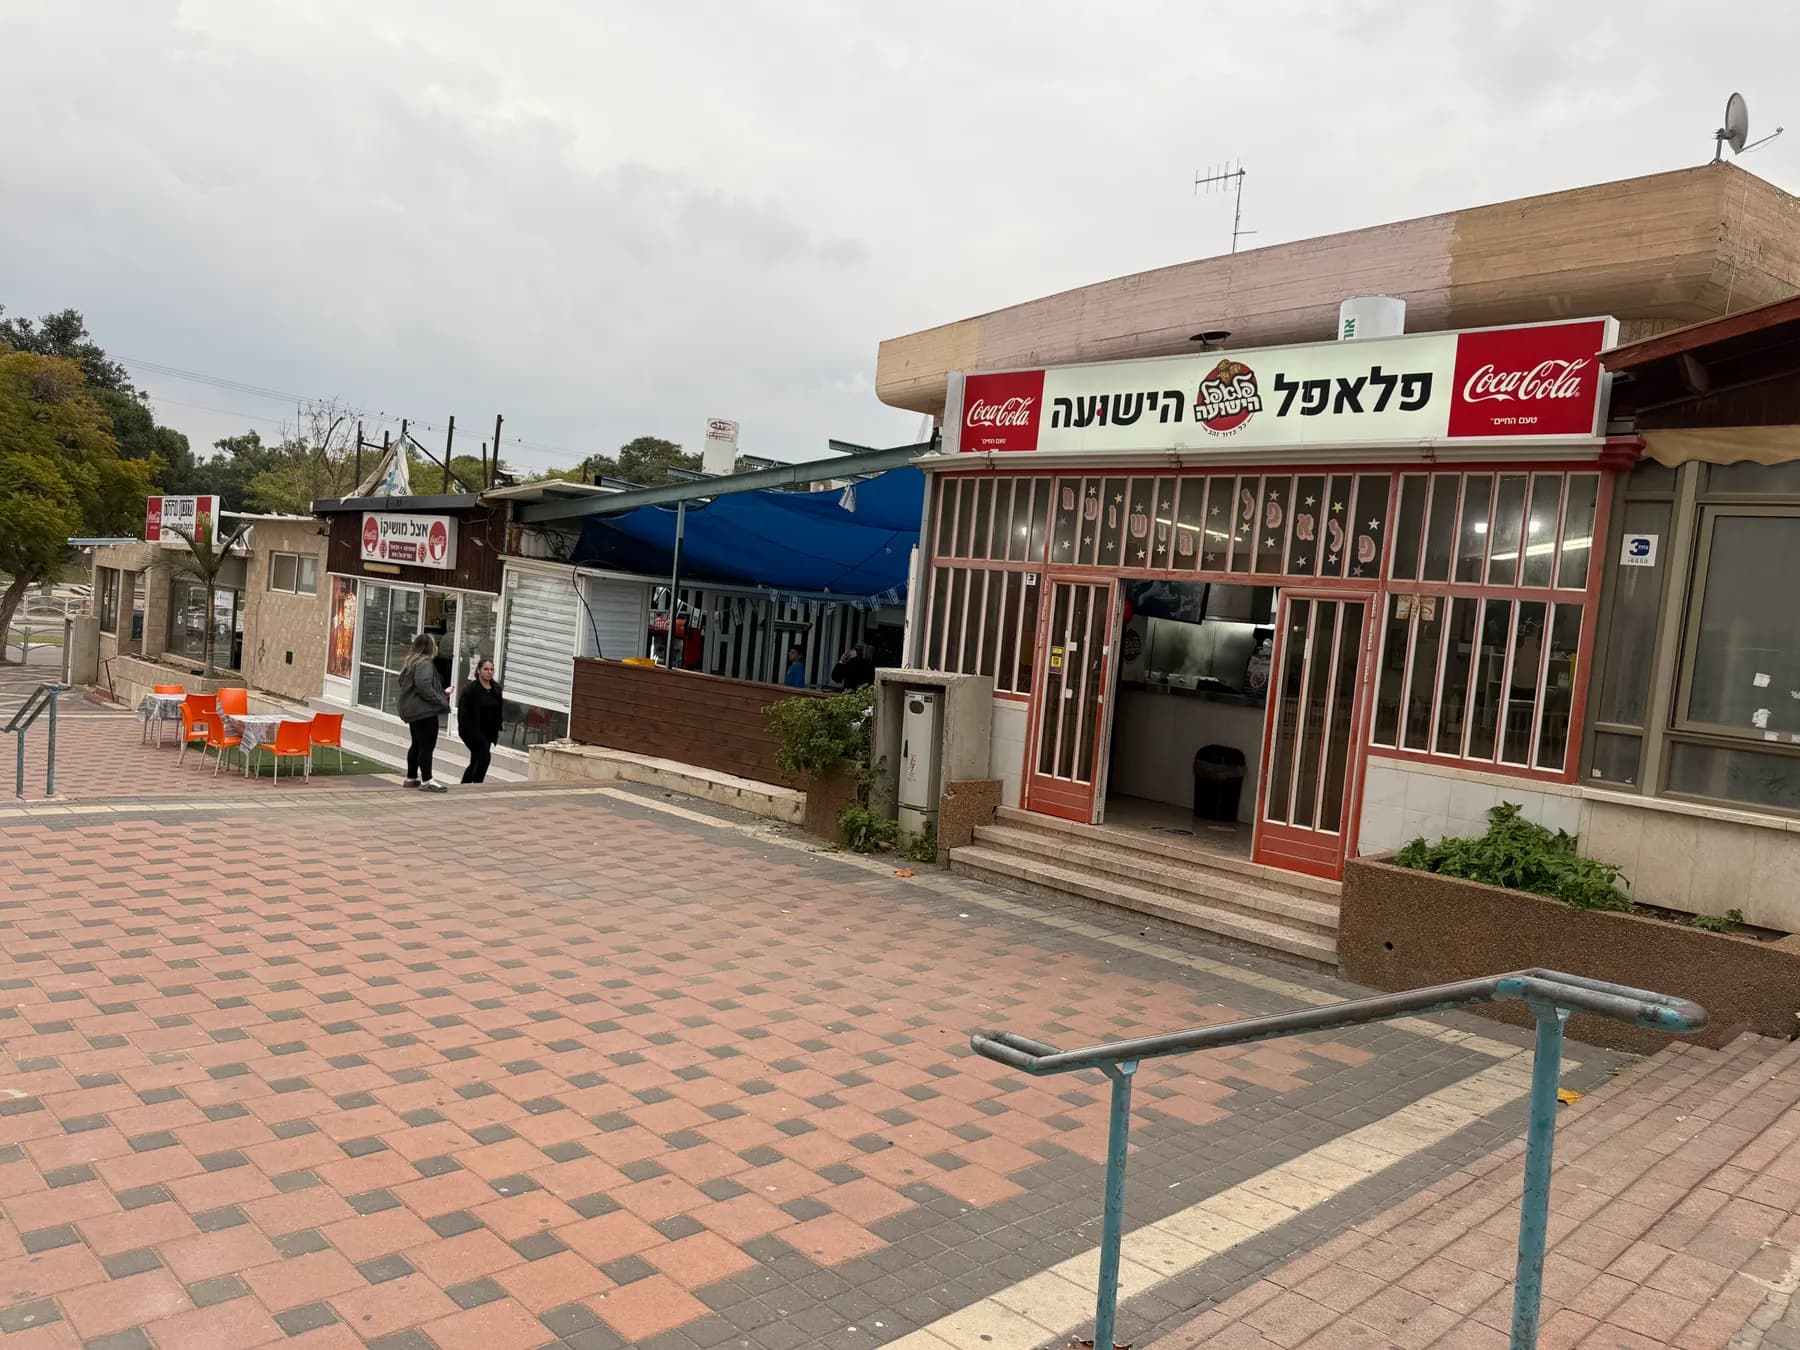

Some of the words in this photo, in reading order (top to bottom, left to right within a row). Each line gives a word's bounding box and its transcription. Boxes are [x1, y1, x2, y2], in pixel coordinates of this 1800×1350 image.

[1201, 372, 1256, 403] פלאפל
[1273, 366, 1433, 417] פלאפל
[1462, 358, 1591, 403] Coca-Cola
[966, 397, 1036, 428] Coca-Cola
[1051, 389, 1185, 428] הישועה
[1194, 395, 1262, 421] הישועה
[1517, 416, 1538, 424] טעם
[380, 517, 408, 538] מושיקו
[410, 519, 429, 538] אצל
